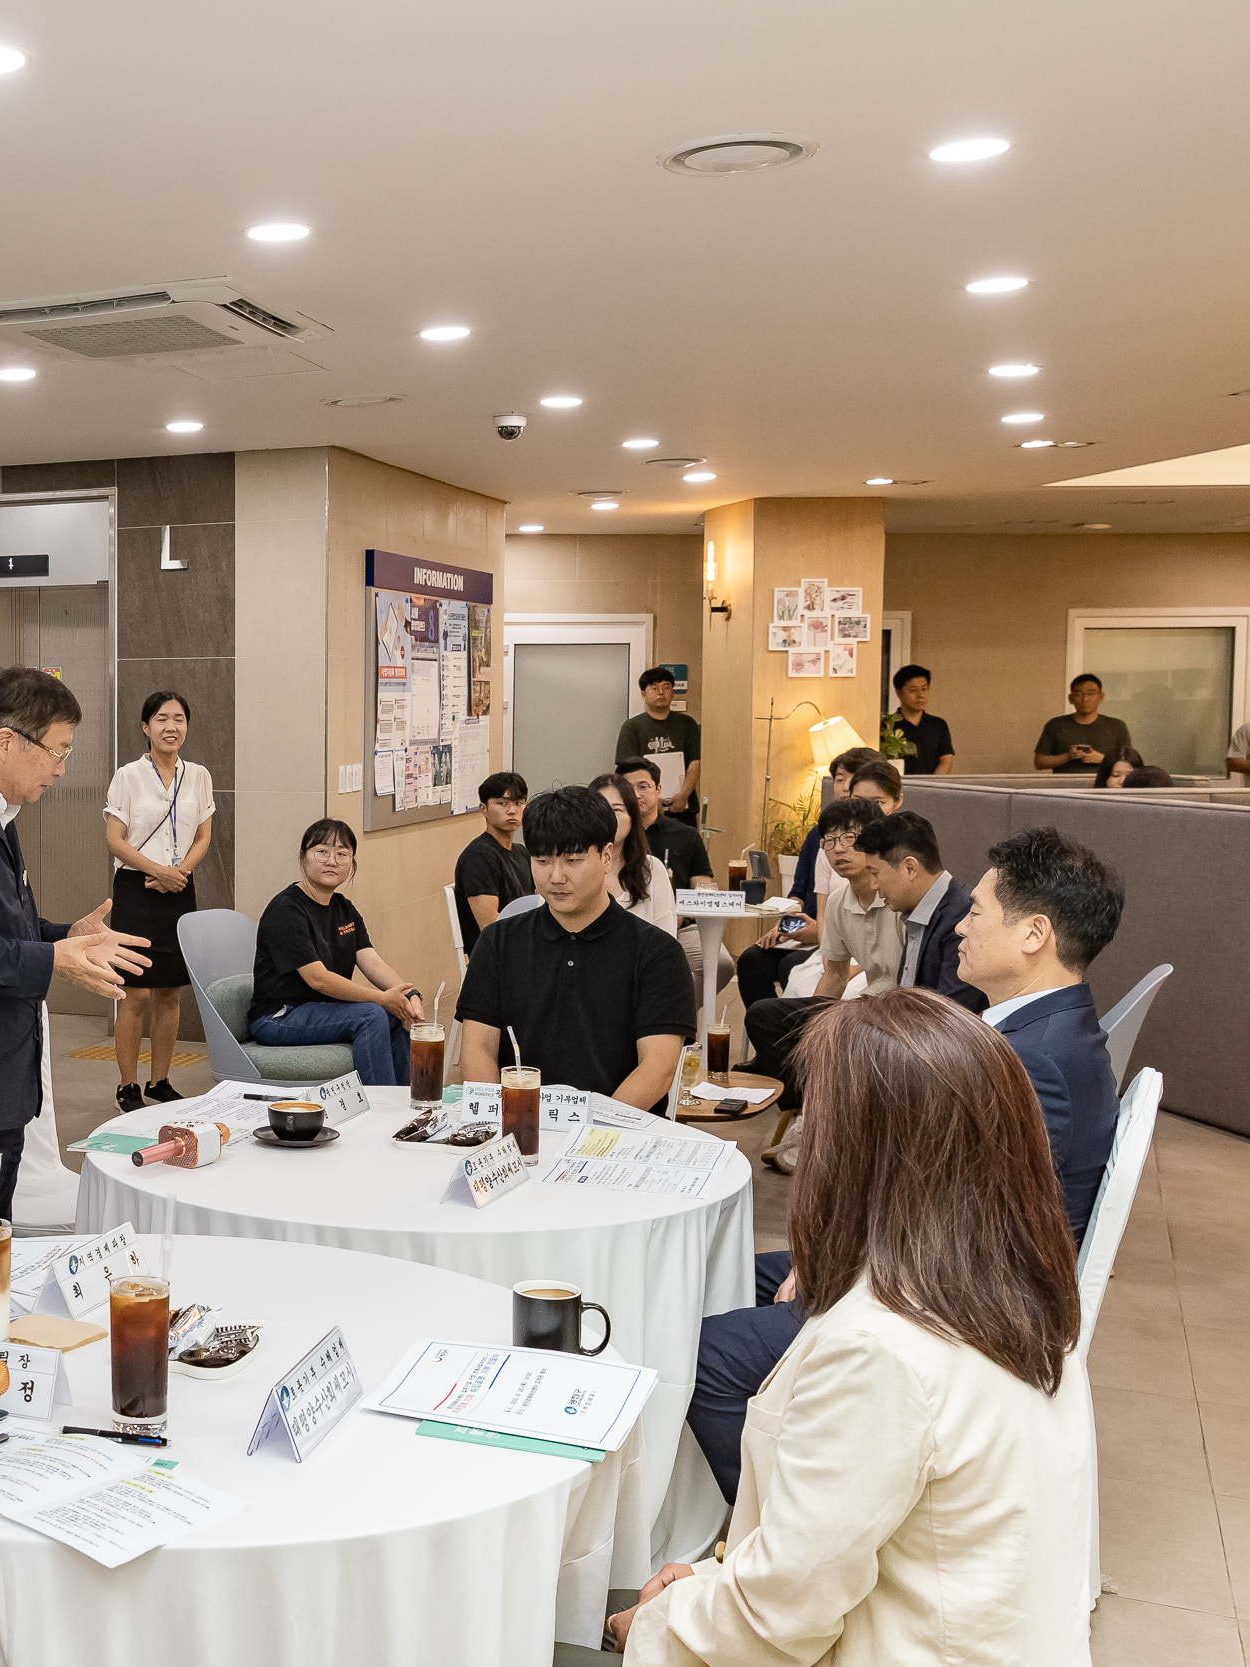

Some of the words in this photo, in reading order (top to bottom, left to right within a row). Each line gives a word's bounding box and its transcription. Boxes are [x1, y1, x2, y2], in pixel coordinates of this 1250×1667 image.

[414, 567, 464, 592] INFORMATION
[556, 1094, 587, 1106] 기부업체
[78, 1233, 128, 1267] 지역경제과장
[290, 1365, 319, 1401] 로봇기부
[319, 1337, 345, 1371] 수혜업체
